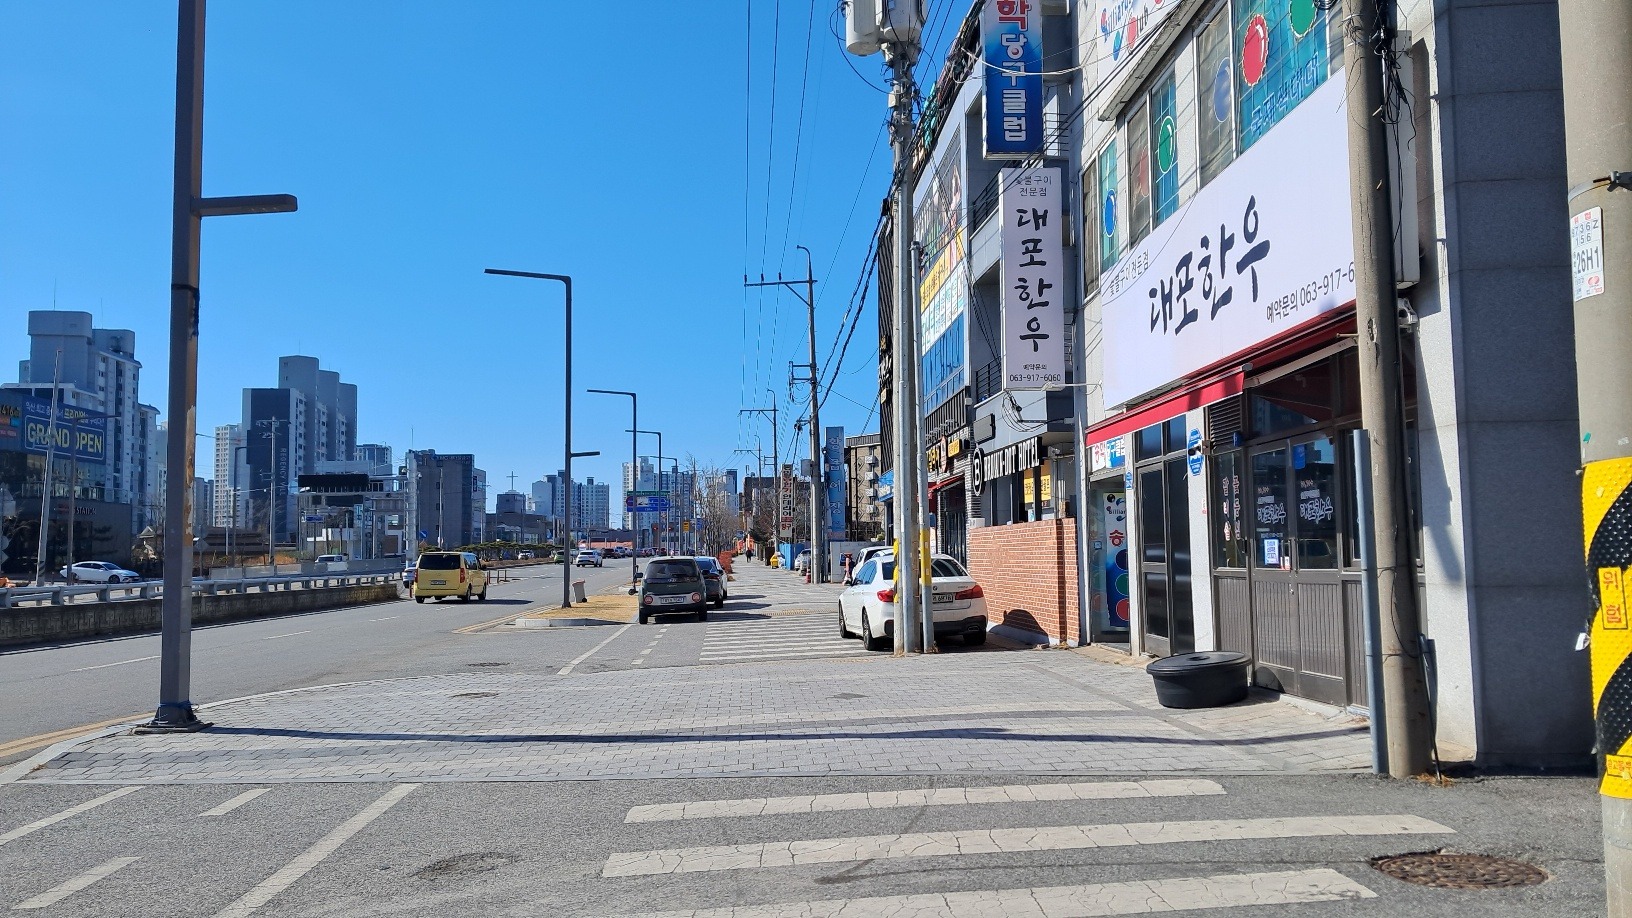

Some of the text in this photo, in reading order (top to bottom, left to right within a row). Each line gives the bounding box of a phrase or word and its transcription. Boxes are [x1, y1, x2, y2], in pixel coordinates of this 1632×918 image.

[1019, 187, 1047, 197] 전문점
[1576, 232, 1592, 246] 156
[1149, 195, 1270, 336] 대포한우
[1576, 246, 1600, 274] 26H1
[1014, 207, 1053, 353] 대포한우
[1266, 290, 1298, 323] 예약문의
[1009, 374, 1061, 382] 063-917-6060
[75, 431, 102, 454] PEN
[1018, 436, 1040, 472] HOTEL
[974, 458, 980, 486] B
[1603, 570, 1622, 624] 위험
